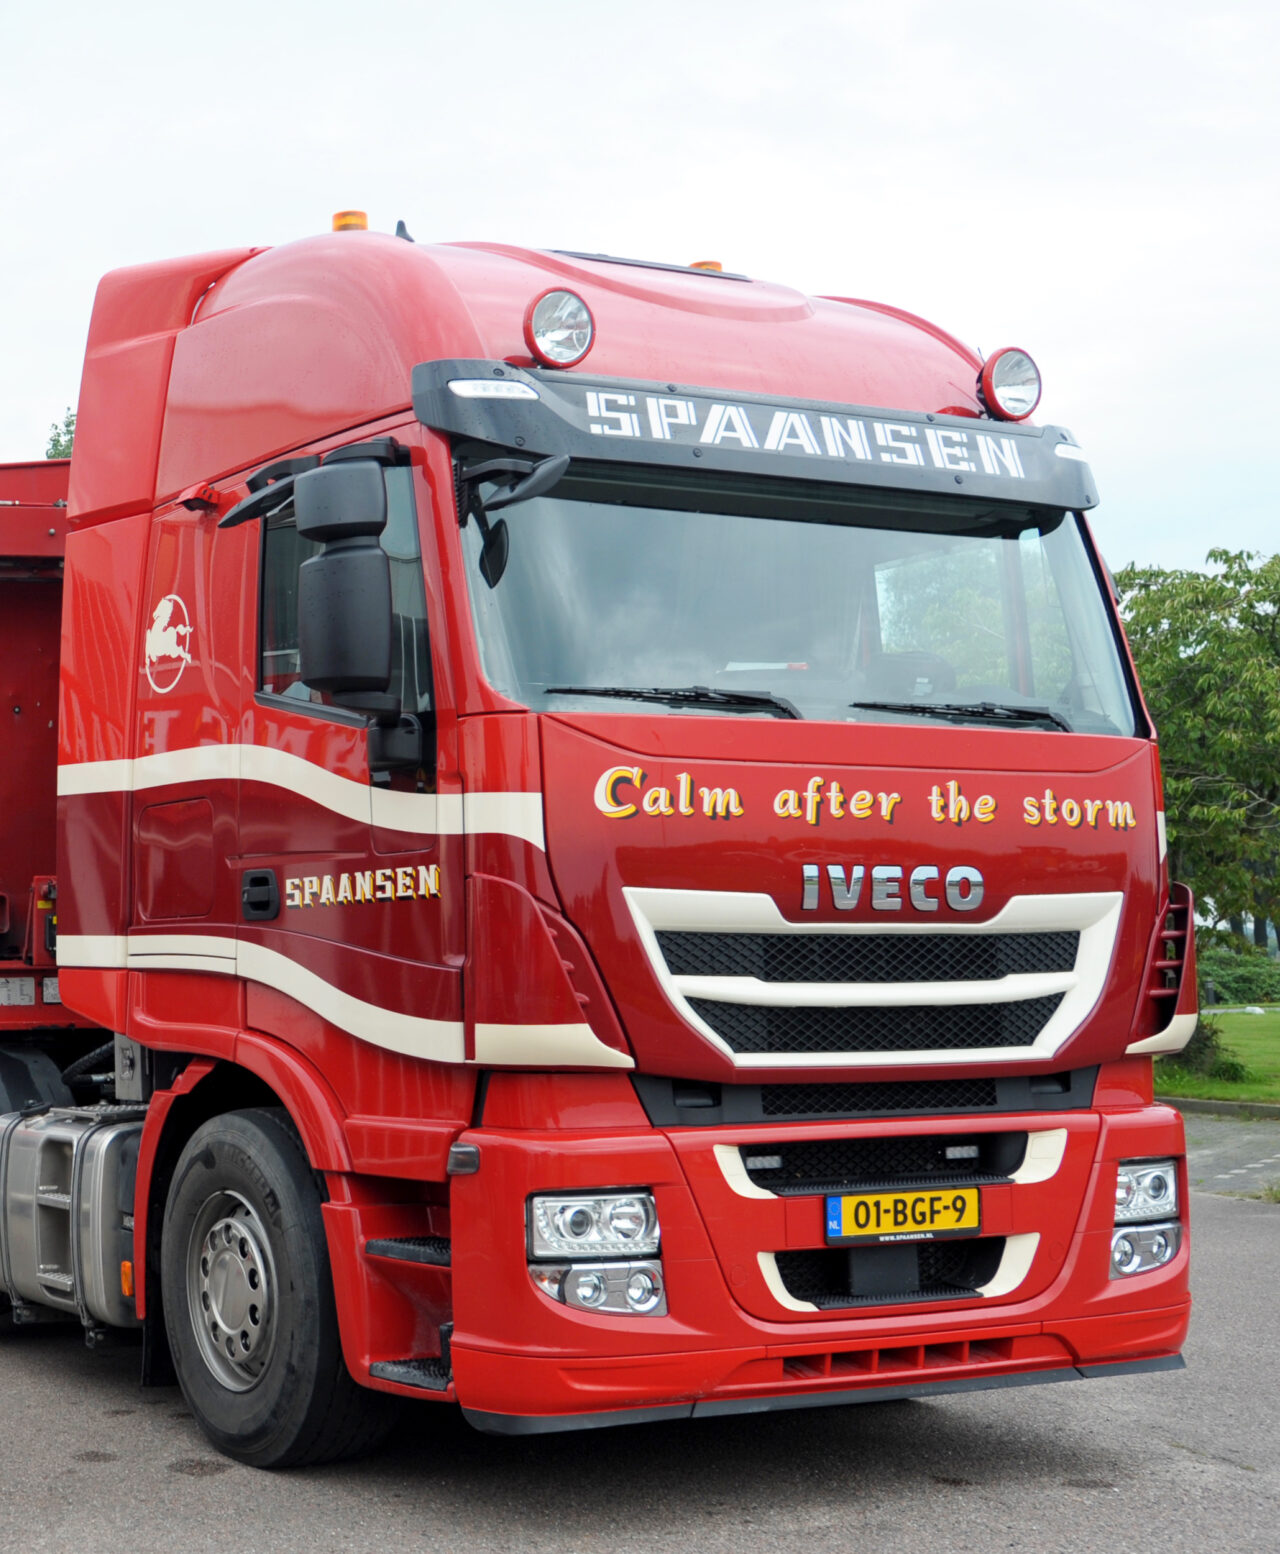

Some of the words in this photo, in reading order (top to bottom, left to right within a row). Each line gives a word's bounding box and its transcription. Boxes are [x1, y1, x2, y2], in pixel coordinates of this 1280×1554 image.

[585, 391, 1025, 479] SPAANSEN
[593, 766, 744, 820] Calm
[773, 776, 901, 825] after
[927, 780, 997, 825] the
[1023, 788, 1137, 829] storm
[285, 864, 442, 909] SPAANSEN
[800, 864, 985, 911] IVECO
[829, 1220, 841, 1230] NL
[854, 1195, 967, 1229] 01-BGF-9
